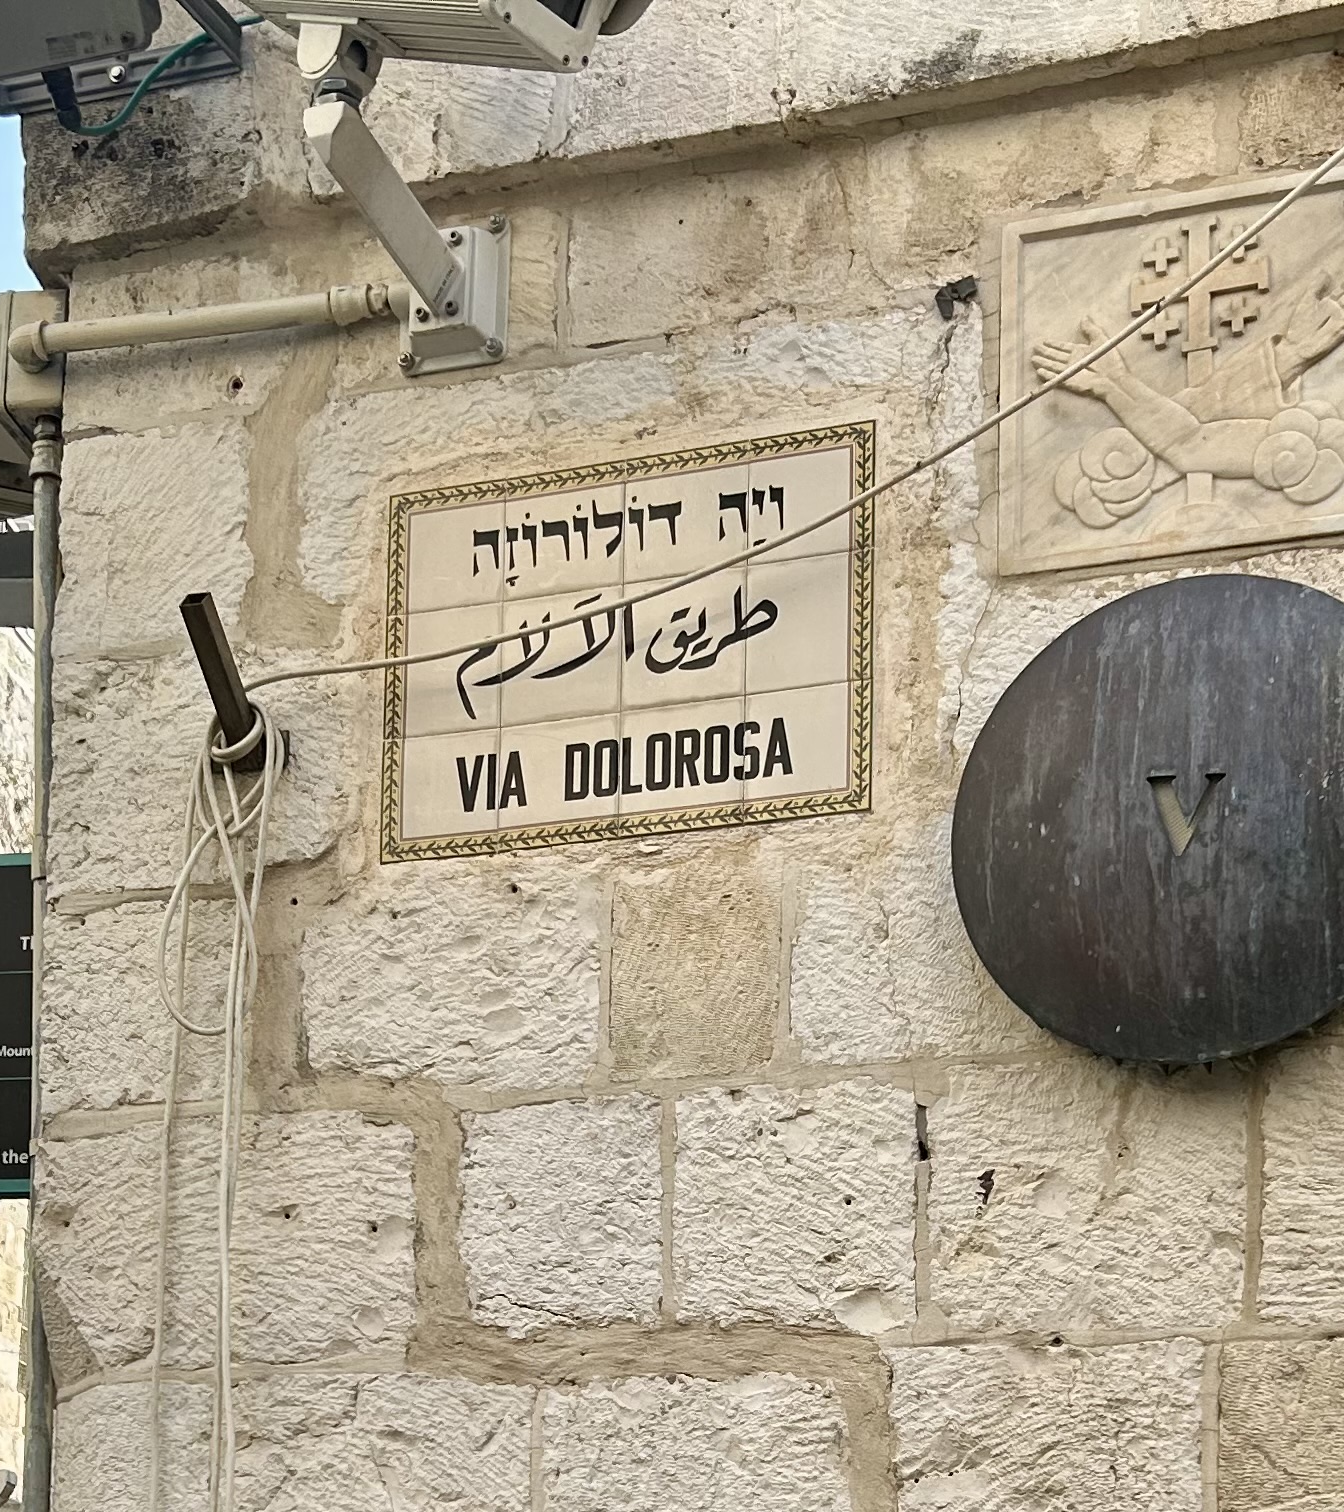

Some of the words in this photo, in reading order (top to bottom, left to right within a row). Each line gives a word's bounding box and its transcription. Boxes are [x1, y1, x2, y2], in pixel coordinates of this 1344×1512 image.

[644, 584, 779, 674] طريق
[456, 750, 528, 814] VIA
[564, 716, 794, 803] DOLOROSA
[1145, 768, 1227, 858] V
[1, 1148, 29, 1165] the
